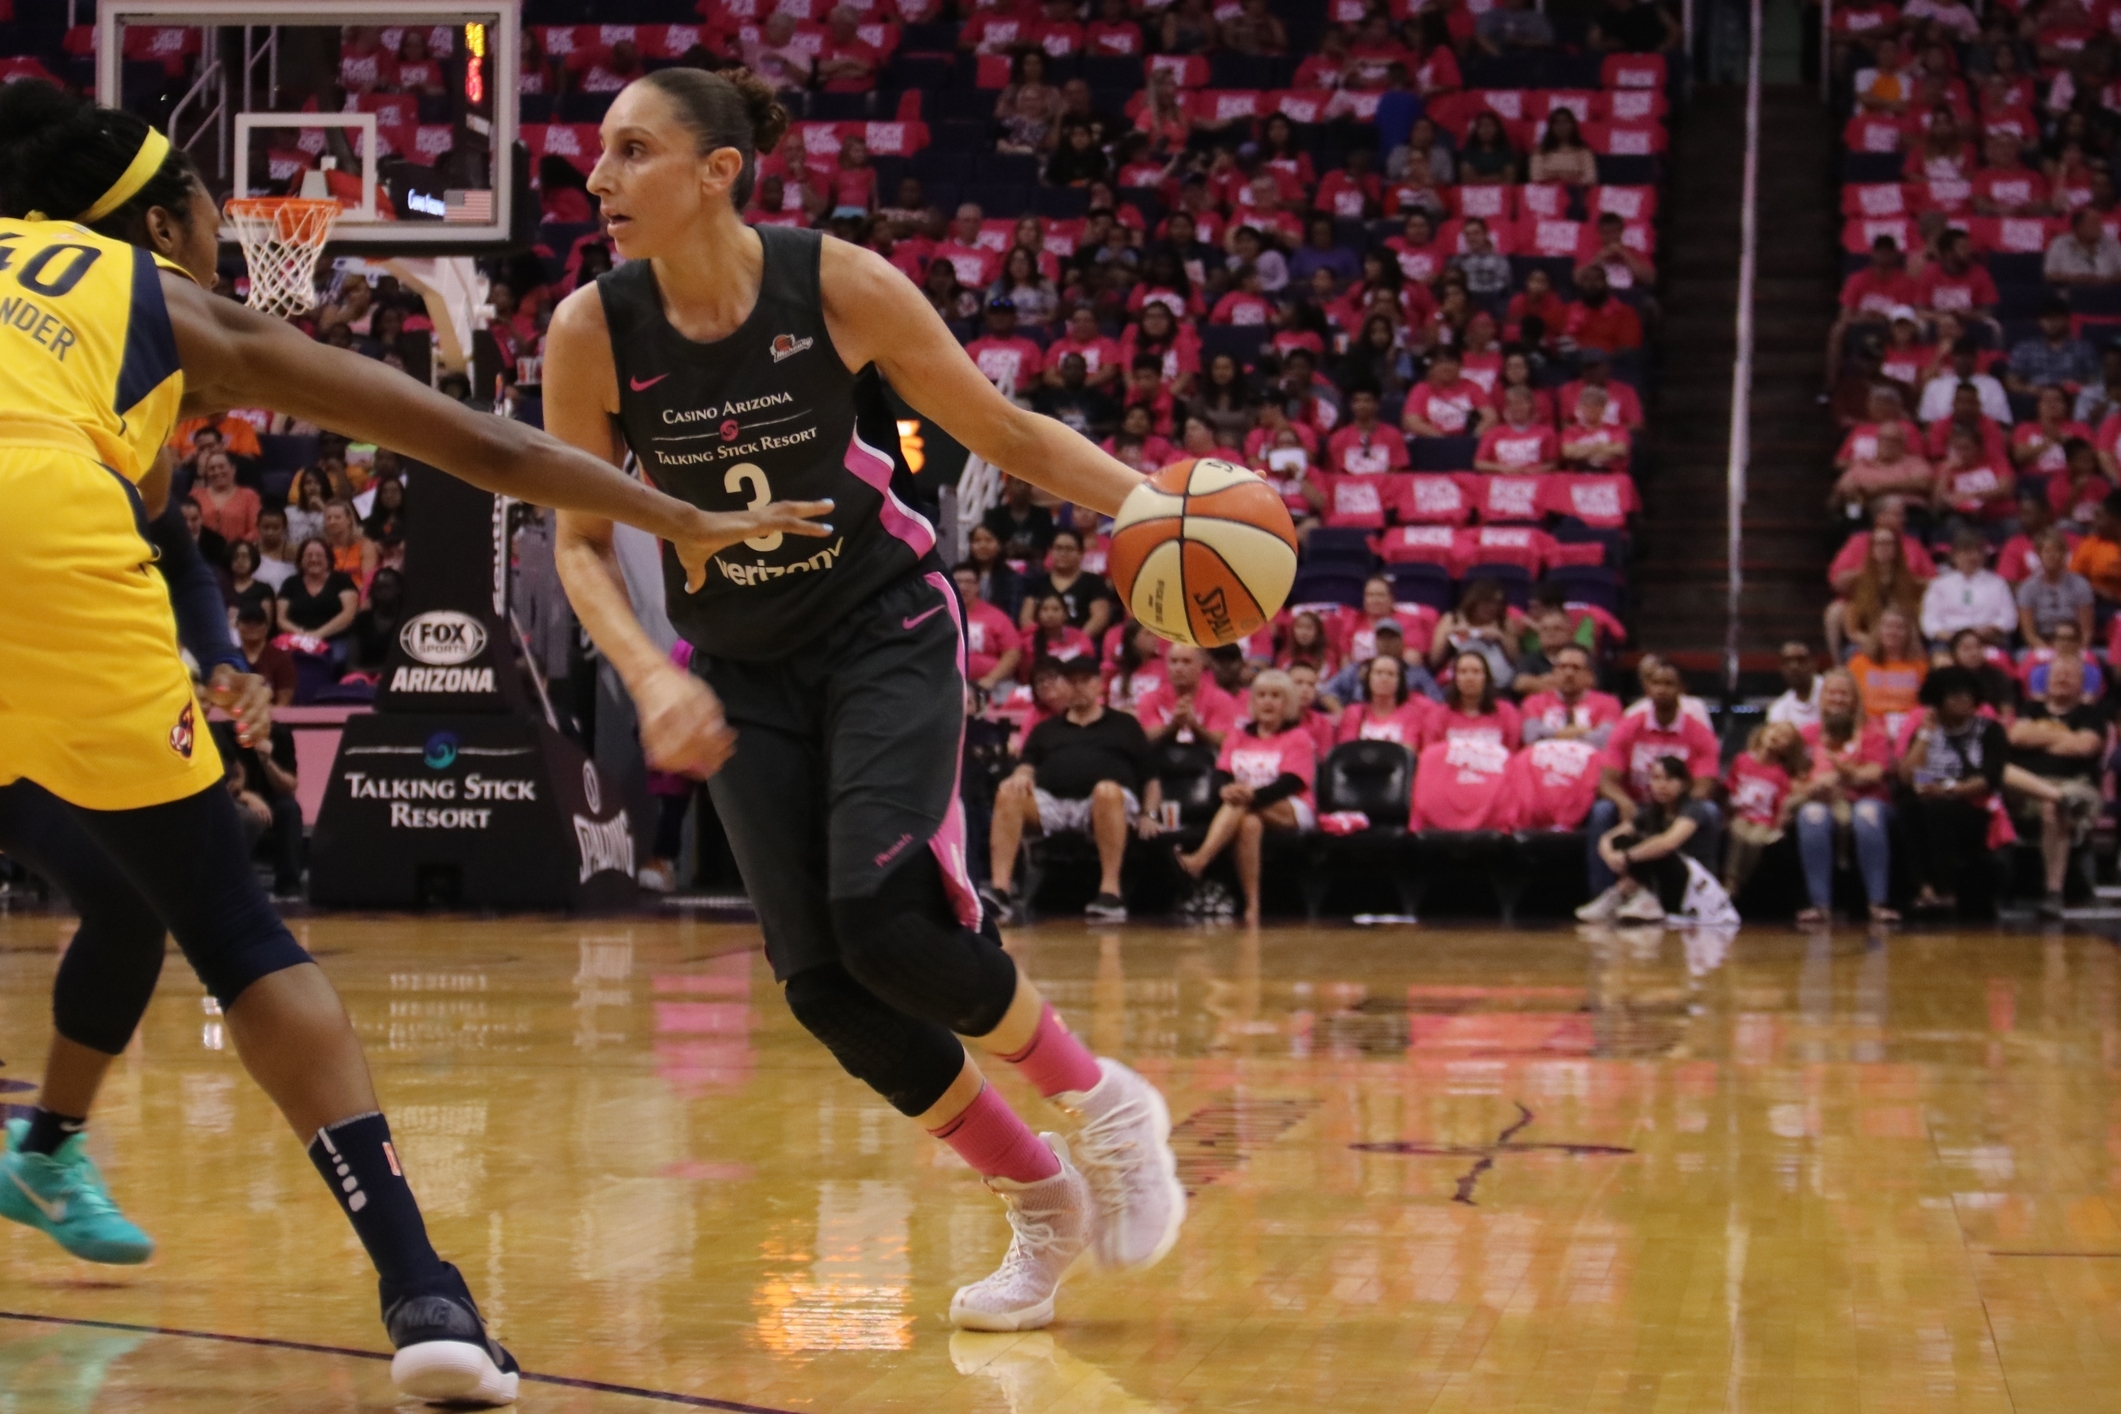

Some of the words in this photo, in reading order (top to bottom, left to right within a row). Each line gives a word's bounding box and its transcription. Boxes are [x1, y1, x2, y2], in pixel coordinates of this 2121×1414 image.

[662, 406, 718, 425] CASINO
[722, 391, 794, 416] ARIZONA
[655, 450, 714, 465] TALKING
[717, 442, 760, 459] STICK
[760, 427, 818, 451] RESORT
[724, 462, 784, 552] 3
[419, 623, 467, 645] FOX
[389, 666, 494, 693] ARIZONA
[344, 772, 456, 799] TALKING
[463, 773, 537, 801] STICK
[390, 801, 493, 829] RESORT
